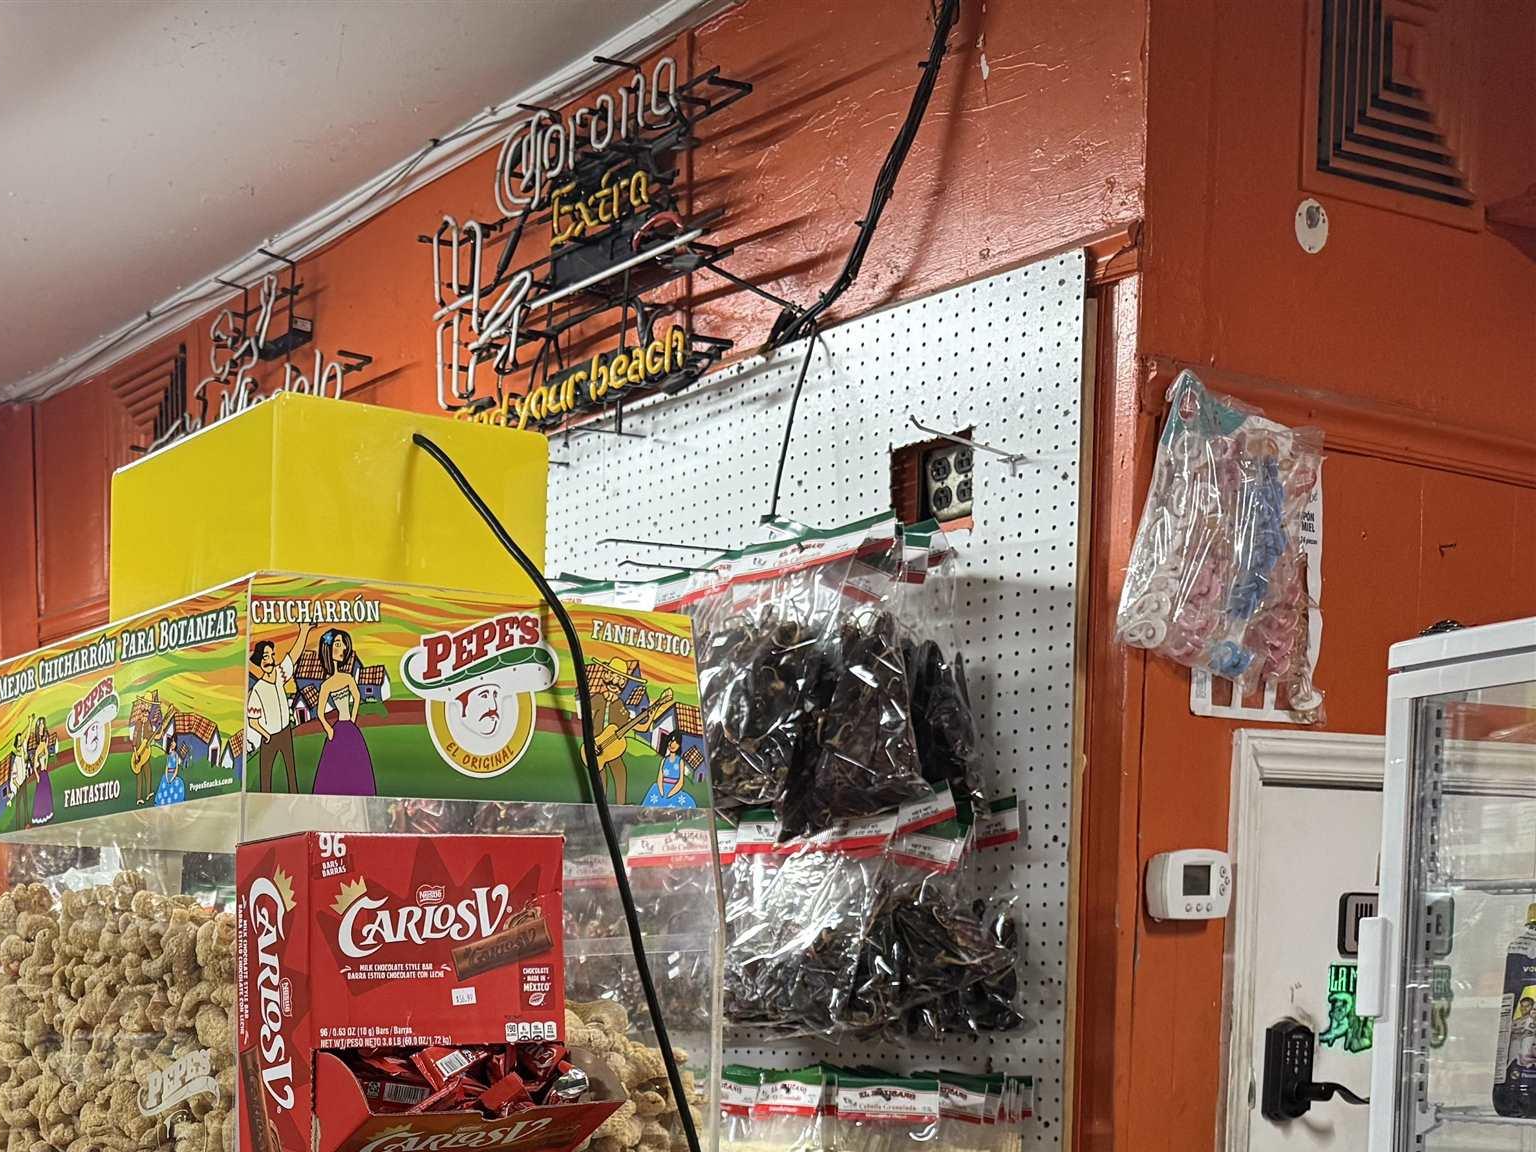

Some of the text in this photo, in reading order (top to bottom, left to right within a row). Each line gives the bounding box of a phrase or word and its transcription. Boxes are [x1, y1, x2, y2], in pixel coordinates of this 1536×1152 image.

[495, 58, 678, 218] Corona
[551, 168, 649, 247] Extra
[516, 324, 684, 430] your beach
[251, 594, 380, 624] CHICHARRÓN
[39, 634, 115, 684] CHICHARRÓN
[121, 629, 155, 659] PARA
[159, 610, 238, 650] BOTANEAR
[422, 615, 540, 680] PEPE'S
[591, 619, 692, 657] FANTASTICO
[73, 678, 113, 728] PEPE'S
[446, 742, 515, 771] EL ORIGINAL
[64, 780, 120, 808] FANTASTICO
[319, 835, 347, 858] 96
[322, 866, 347, 878] BARRAS
[376, 963, 404, 971] CHOCOLATE
[386, 971, 416, 979] CHOCOLATE
[417, 971, 429, 979] CON
[320, 1027, 328, 1037] 96
[332, 1027, 346, 1036] 0.63
[347, 1027, 356, 1036] OZ
[375, 1026, 389, 1035] Bars
[394, 1025, 412, 1035] Barras
[320, 1038, 333, 1048] NET
